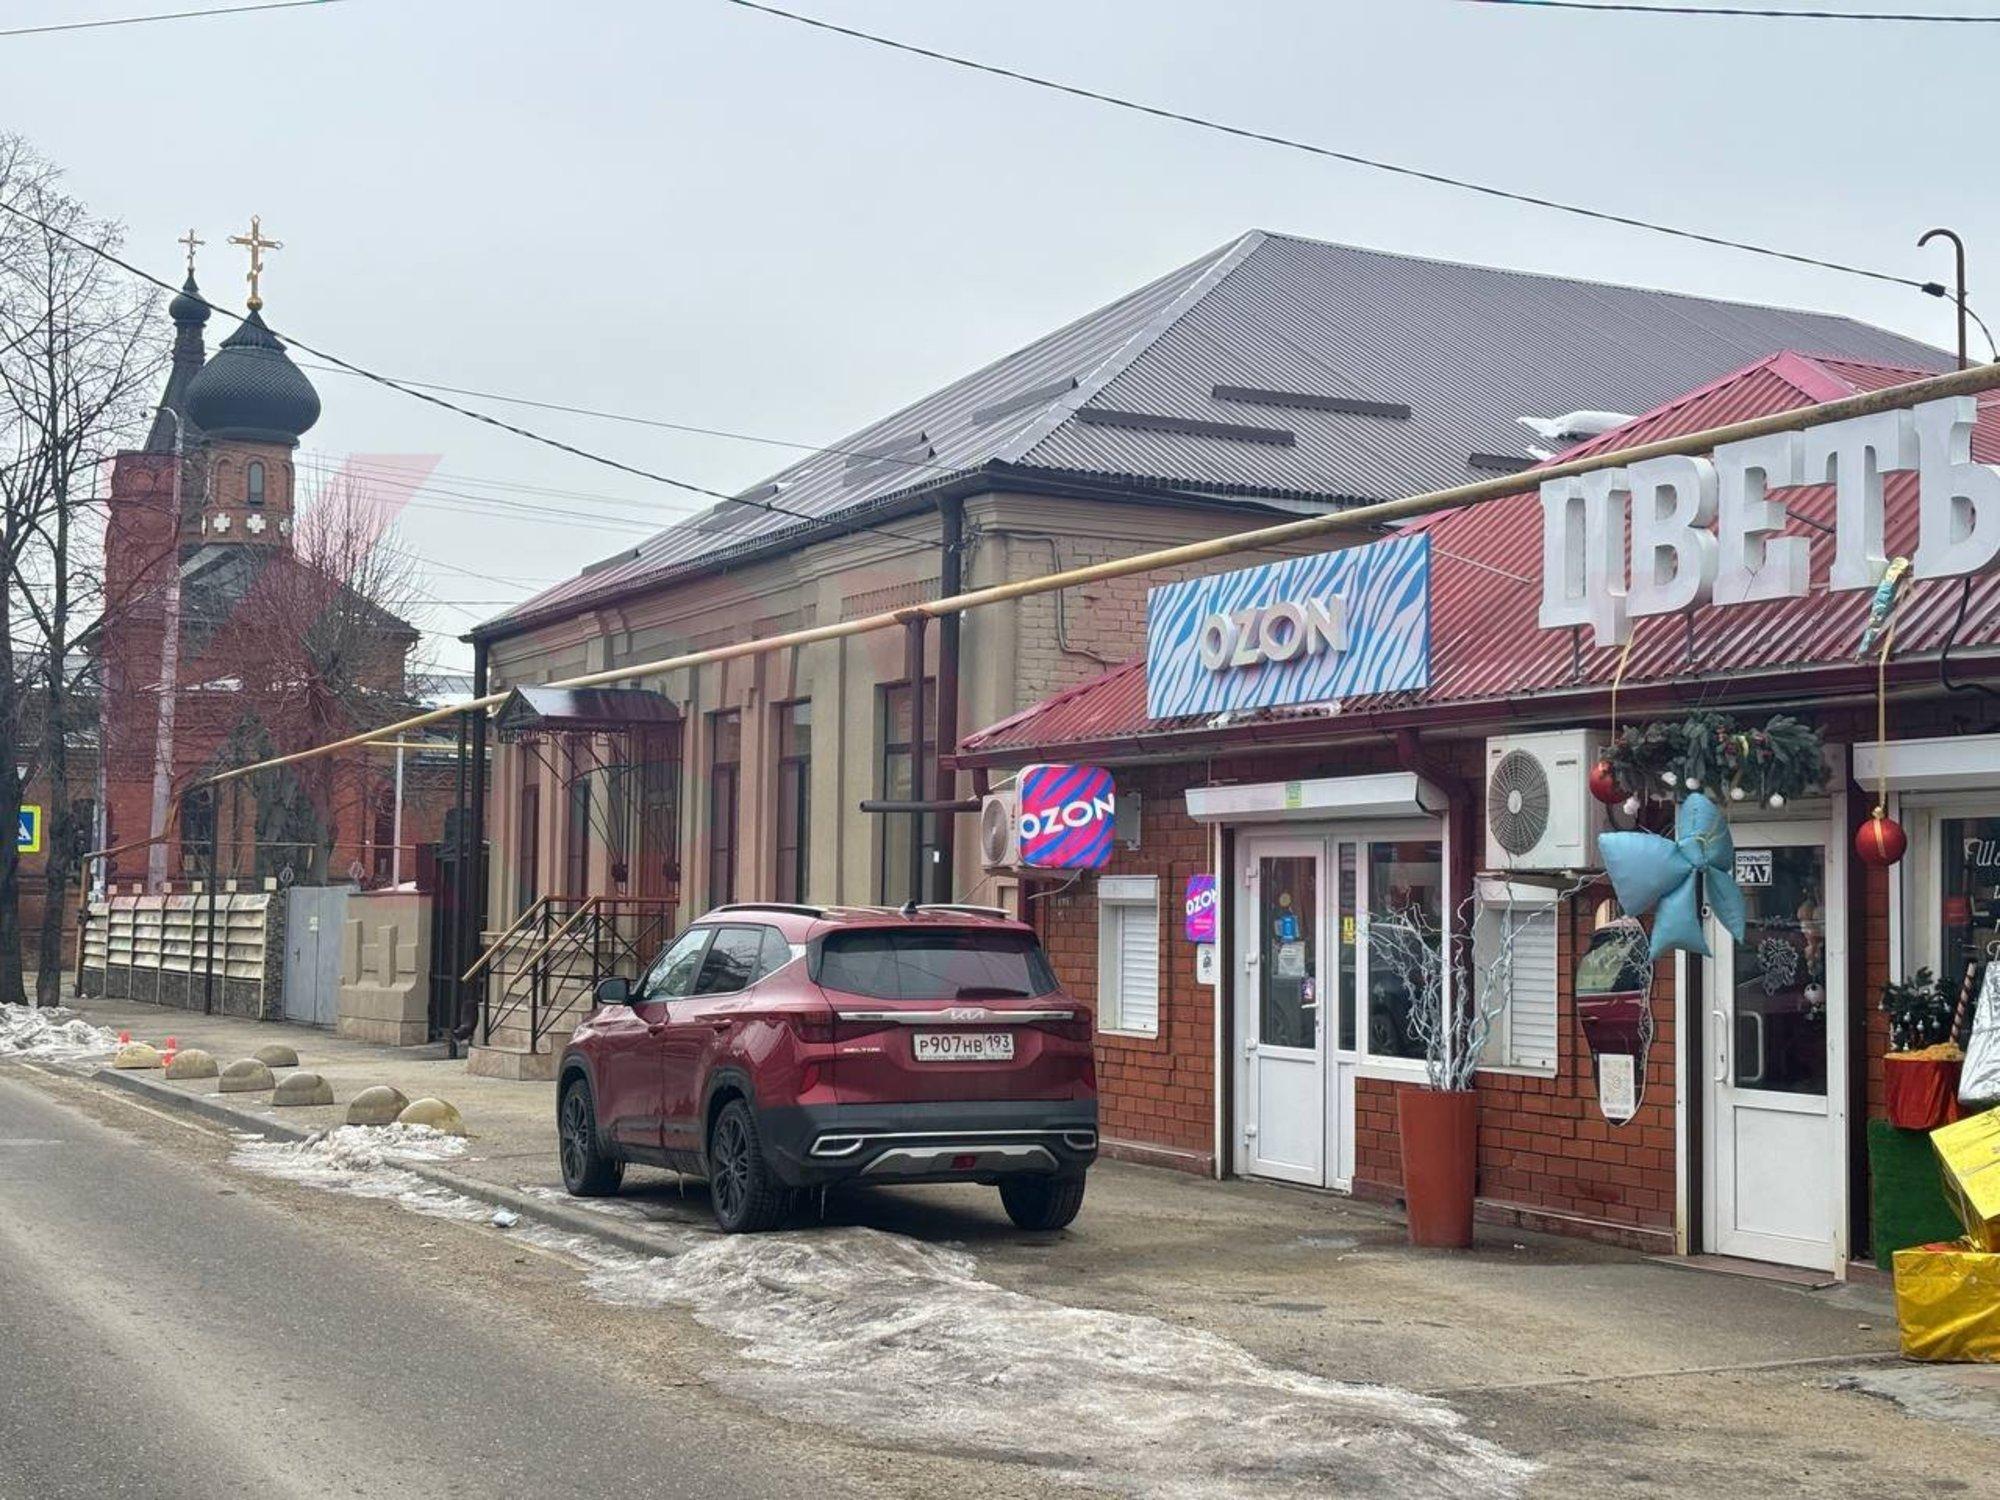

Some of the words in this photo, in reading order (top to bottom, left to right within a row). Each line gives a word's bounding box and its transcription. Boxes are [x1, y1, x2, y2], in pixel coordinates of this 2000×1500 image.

[1200, 594, 1349, 672] OZON
[1019, 792, 1115, 840] OZON
[986, 1035, 1010, 1049] 193
